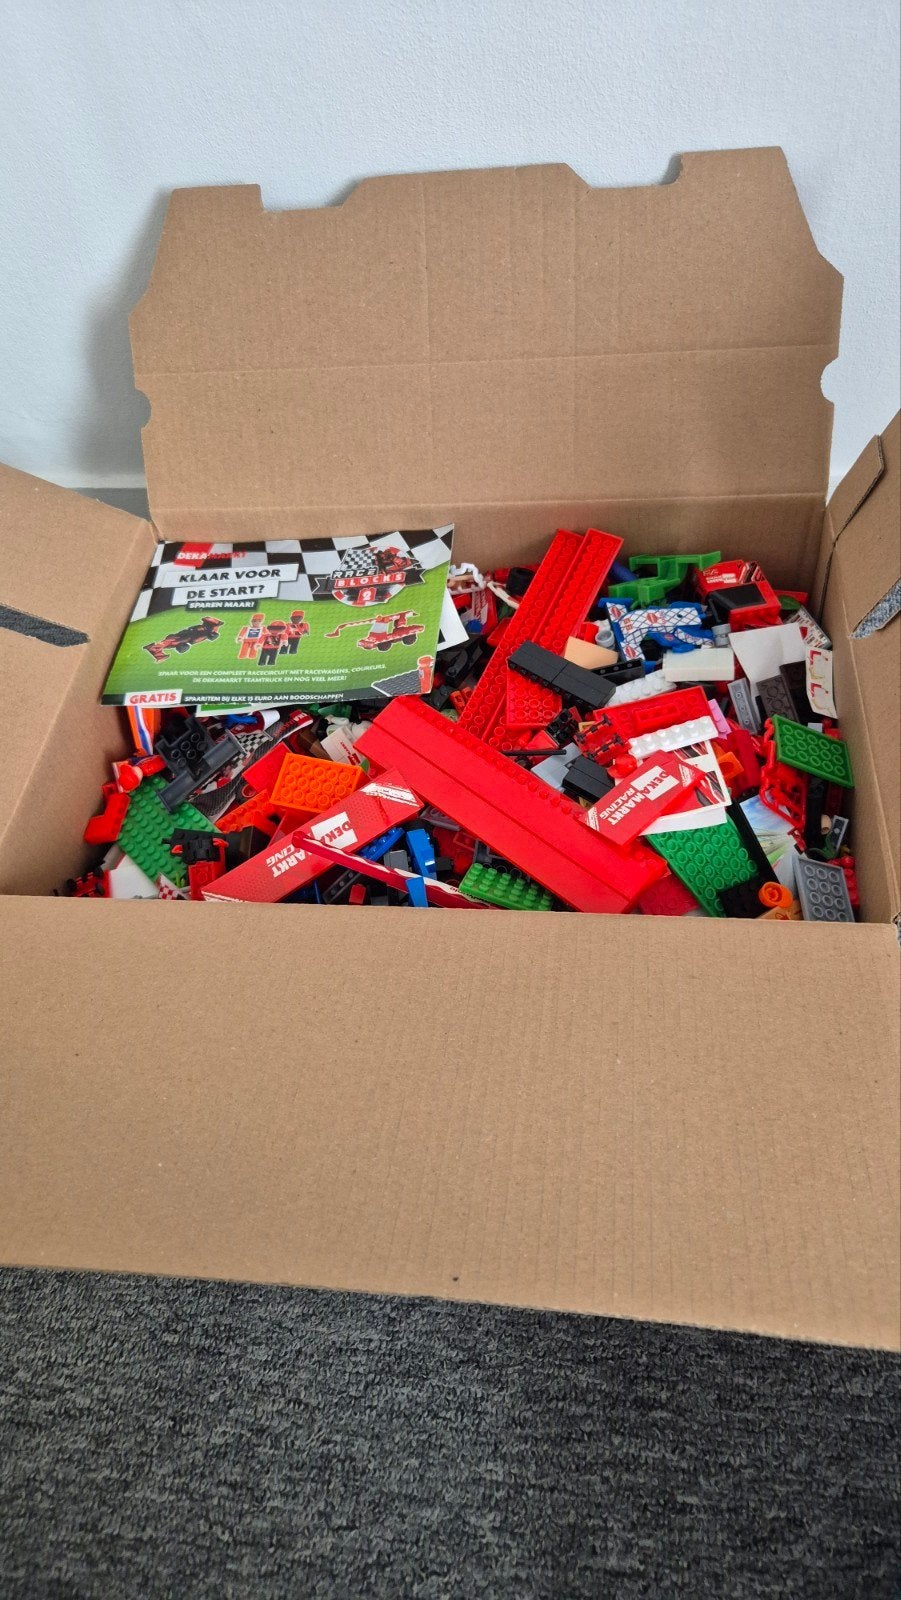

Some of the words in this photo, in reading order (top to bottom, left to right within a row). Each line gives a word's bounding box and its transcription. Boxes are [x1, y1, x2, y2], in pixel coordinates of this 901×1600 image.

[177, 551, 246, 560] DEKAMARKT
[179, 572, 229, 583] KLAAR
[236, 569, 281, 580] VOOR
[333, 568, 377, 578] RACE
[338, 573, 403, 587] BLOCKS
[187, 590, 205, 599] DE
[210, 585, 265, 598] START?
[189, 601, 222, 609] SPAREN
[129, 692, 176, 704] GRATIS
[600, 787, 636, 820] RACING
